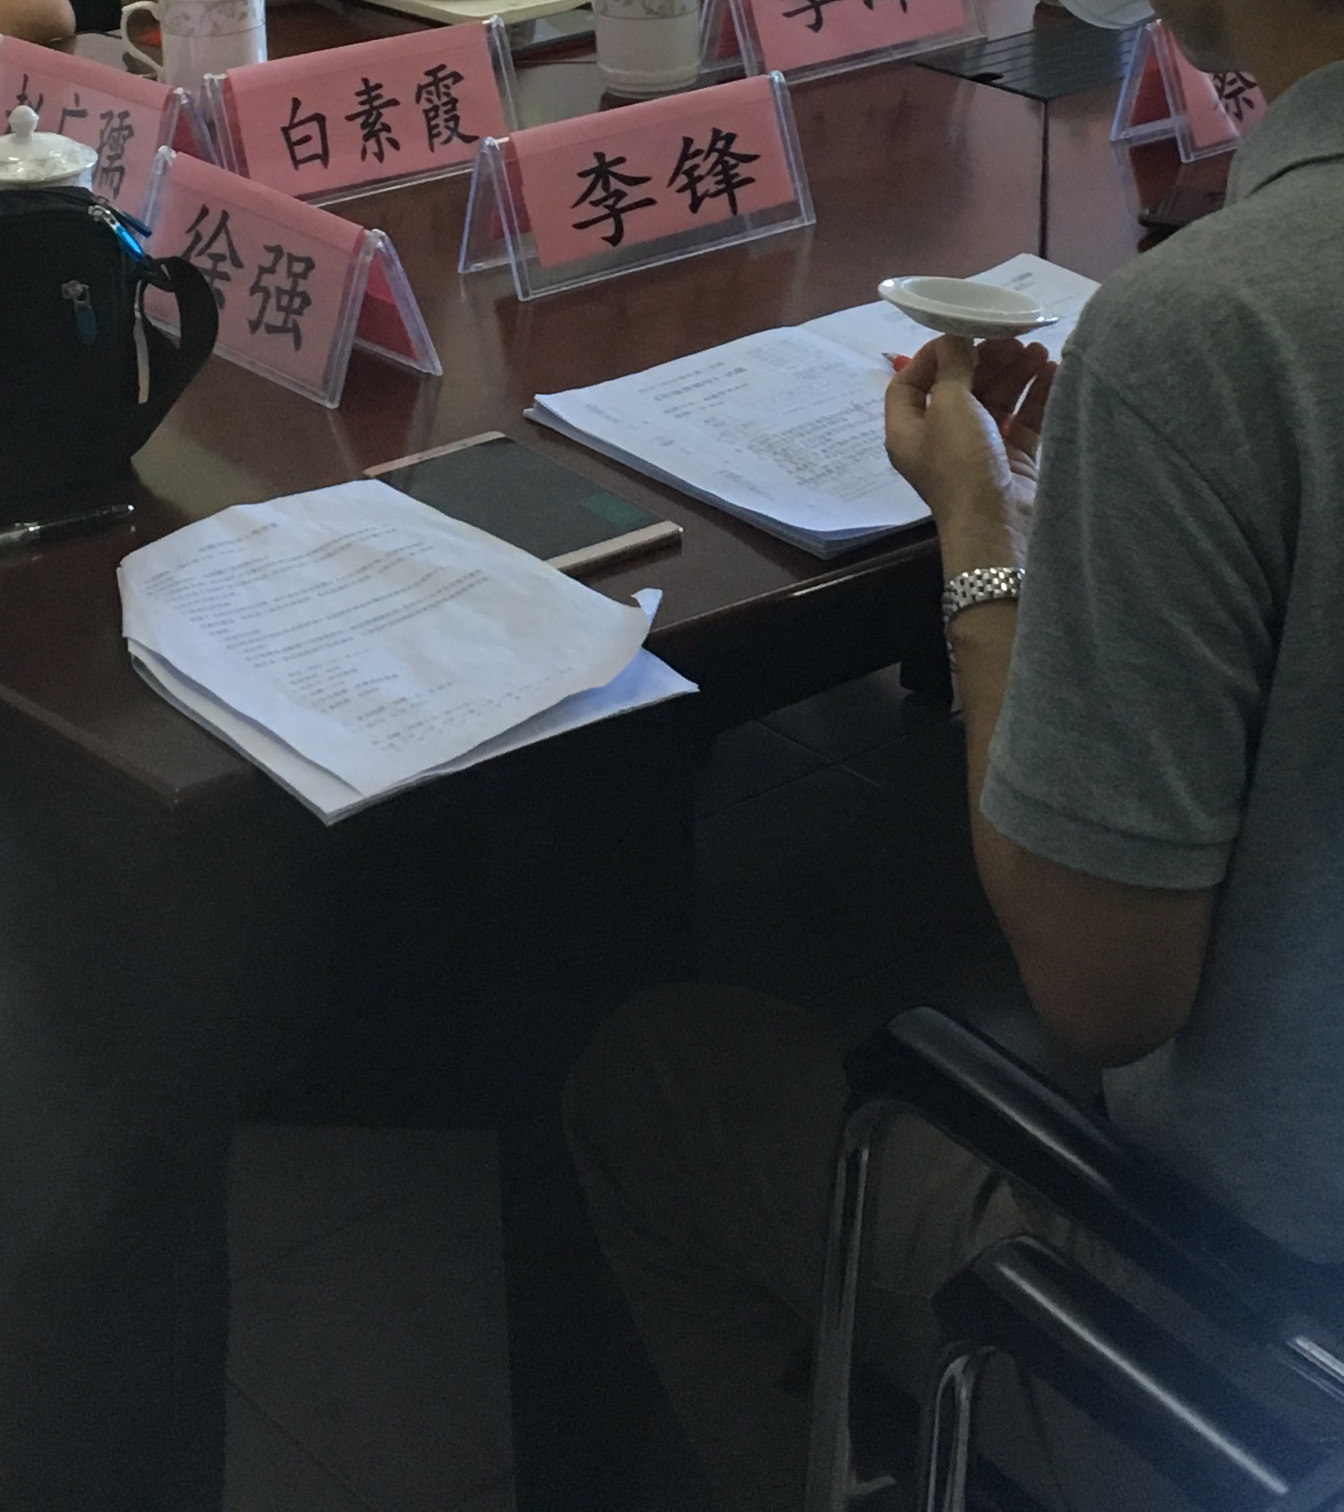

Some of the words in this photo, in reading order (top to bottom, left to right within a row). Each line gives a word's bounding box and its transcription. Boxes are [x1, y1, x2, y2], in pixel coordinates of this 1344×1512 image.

[280, 64, 480, 172] 白素霞
[570, 127, 761, 247] 李锋
[181, 204, 316, 352] 徐强
